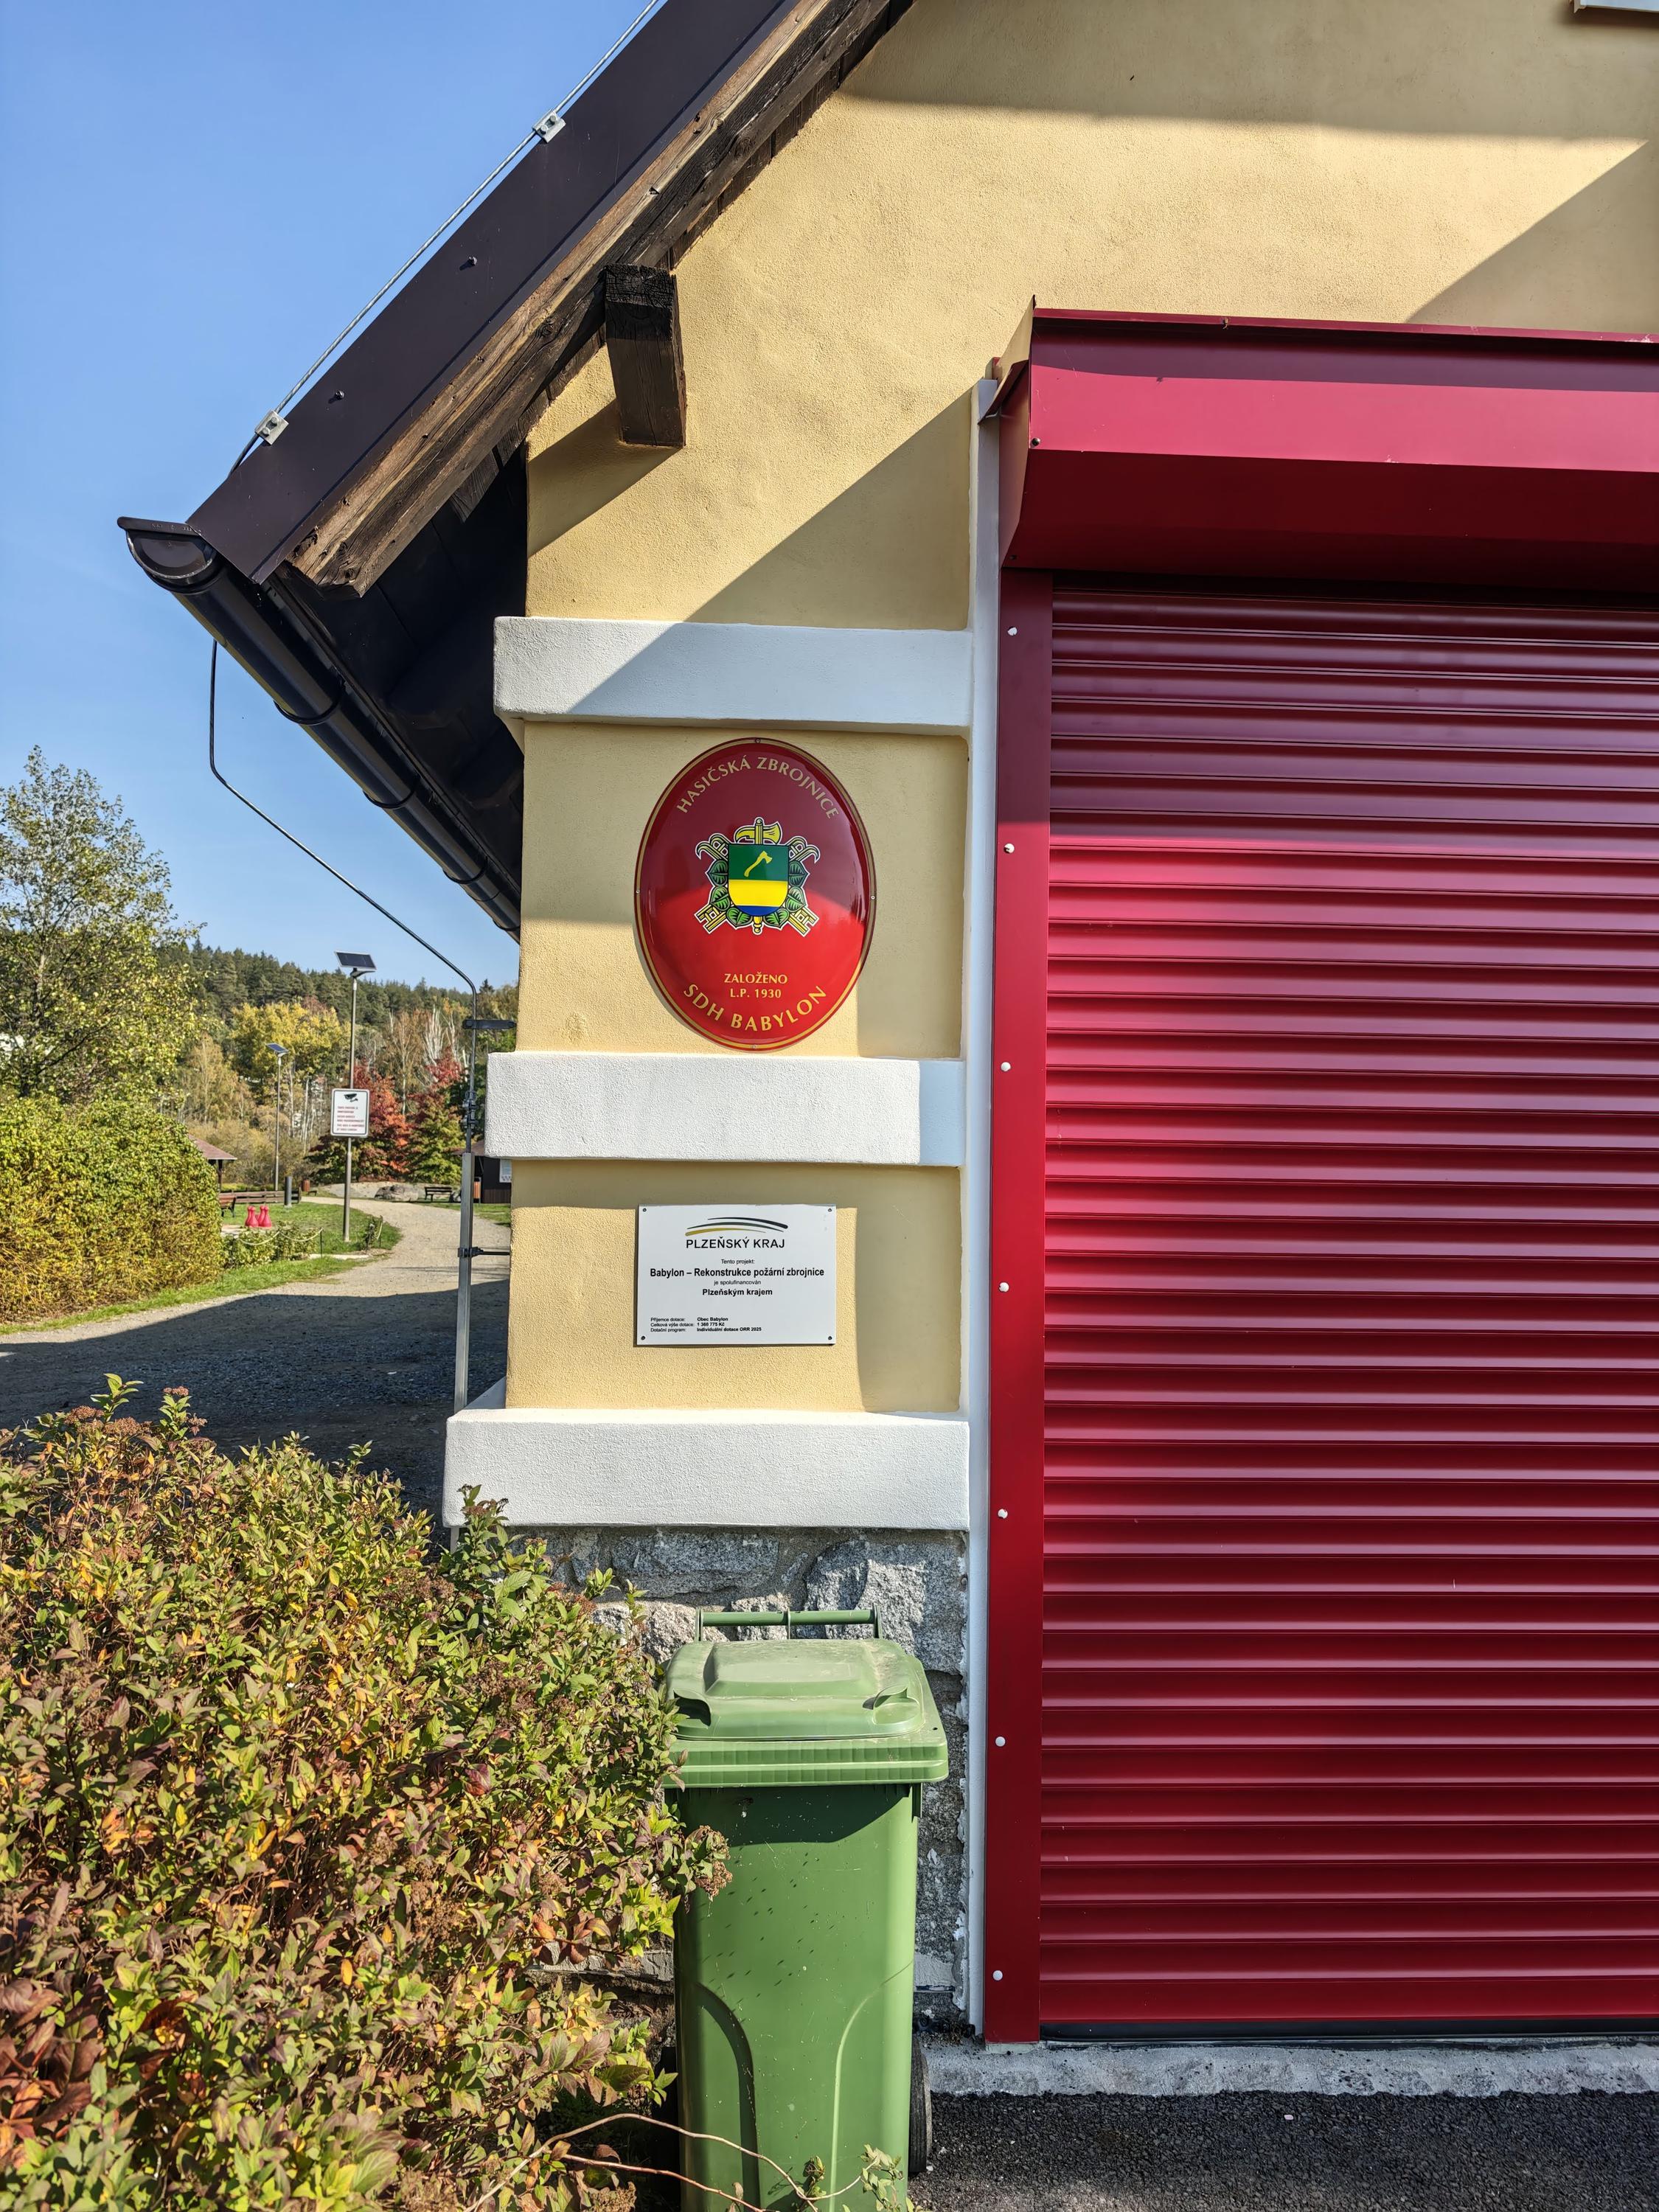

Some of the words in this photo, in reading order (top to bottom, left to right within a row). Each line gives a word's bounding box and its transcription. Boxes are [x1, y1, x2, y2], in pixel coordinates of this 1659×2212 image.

[676, 754, 751, 813] HASIČSKÁ
[757, 757, 839, 819] ZBROJNICE
[724, 971, 788, 984] ZALOŽENO
[730, 989, 750, 998] L.P.
[754, 989, 782, 999] 1930
[684, 984, 724, 1021] SDH
[731, 985, 827, 1032] BABYLON
[686, 1236, 750, 1249] PLZEŇSKÝ
[754, 1239, 785, 1249] KRAJ
[650, 1267, 684, 1279] Babylon
[694, 1267, 751, 1277] Rekonstrukce
[754, 1267, 785, 1279] požární
[786, 1267, 824, 1279] zbrojnice
[702, 1288, 745, 1298] Plzeňským
[746, 1288, 773, 1297] krajem
